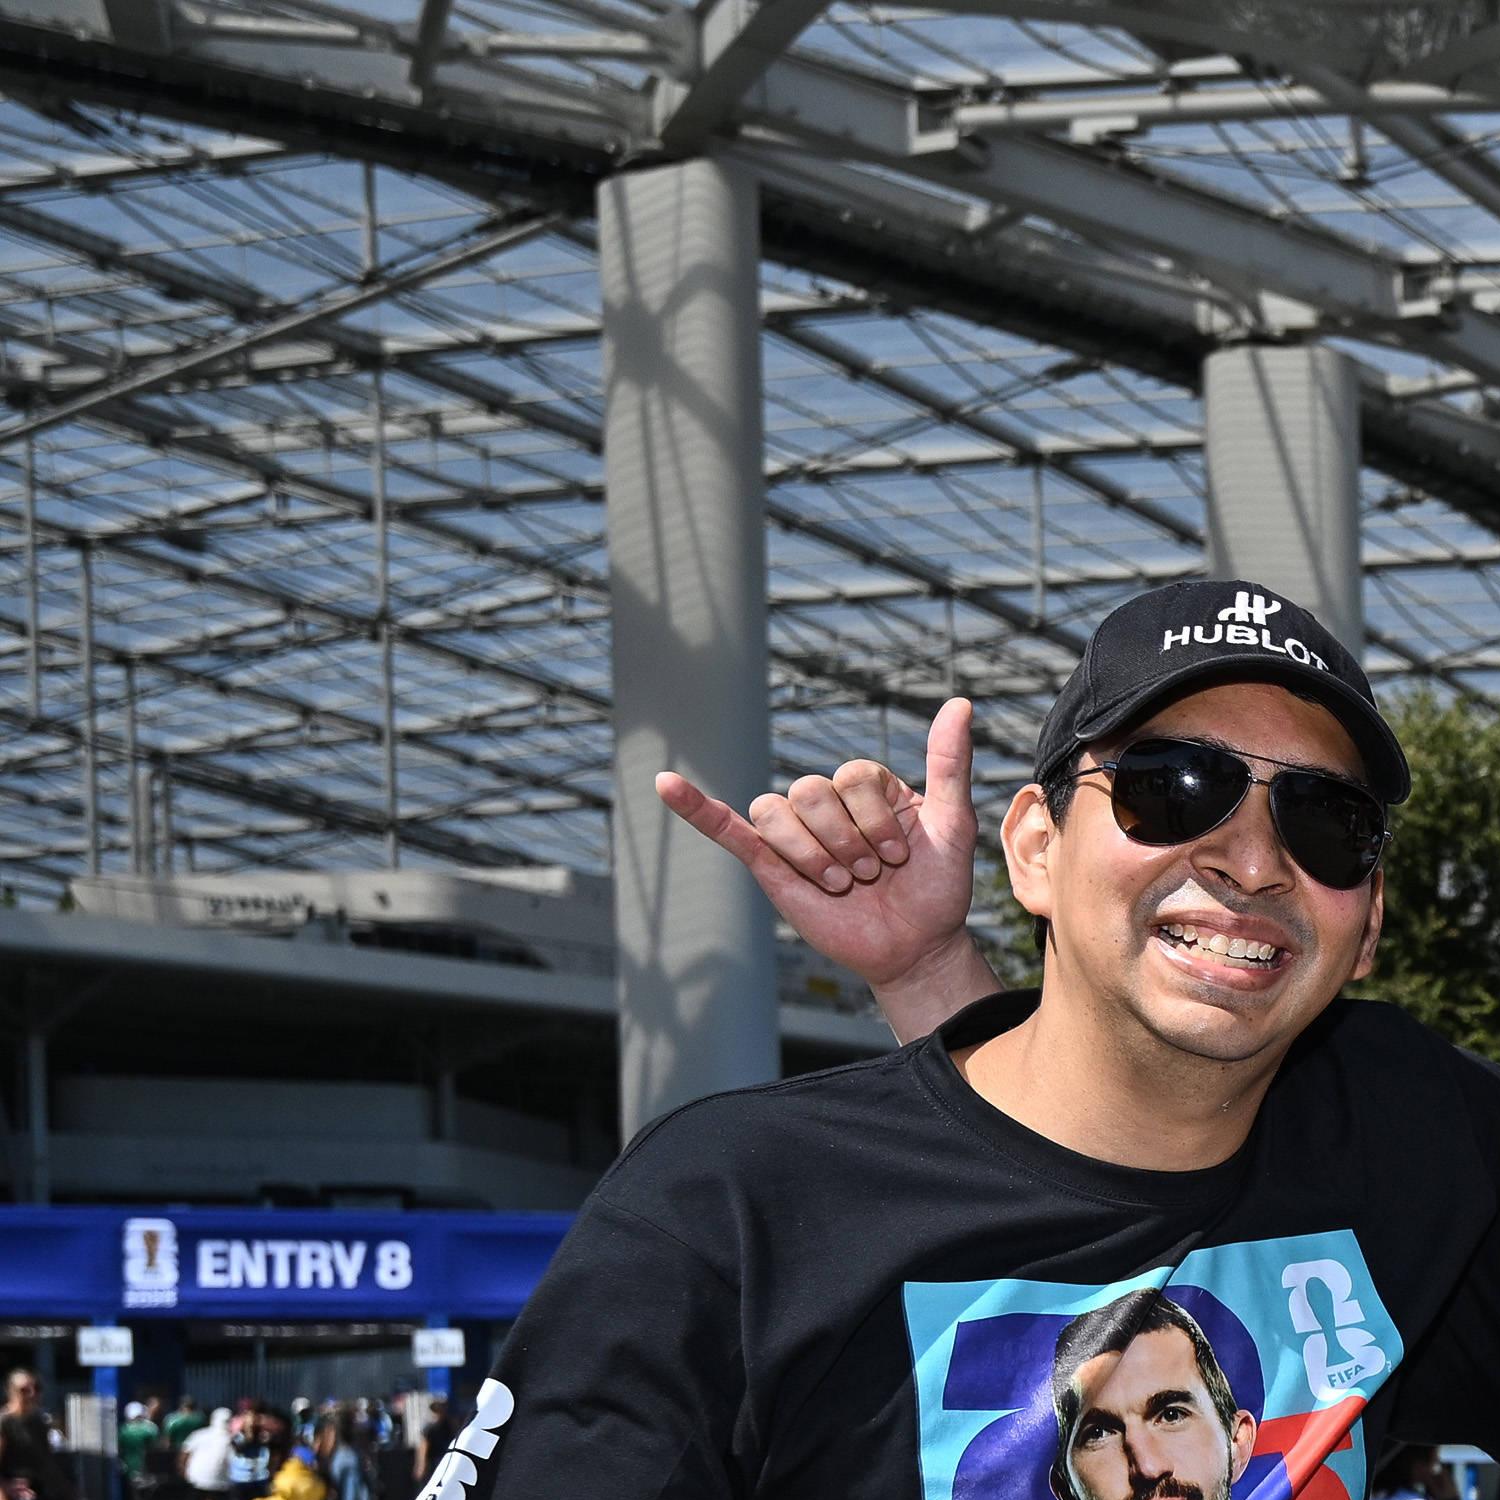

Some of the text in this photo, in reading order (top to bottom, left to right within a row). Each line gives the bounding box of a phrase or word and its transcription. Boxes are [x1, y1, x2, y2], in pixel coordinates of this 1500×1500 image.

[1163, 625, 1329, 671] HUBLOT
[196, 1239, 413, 1290] ENTRY 8
[1327, 1364, 1366, 1388] FIFA
